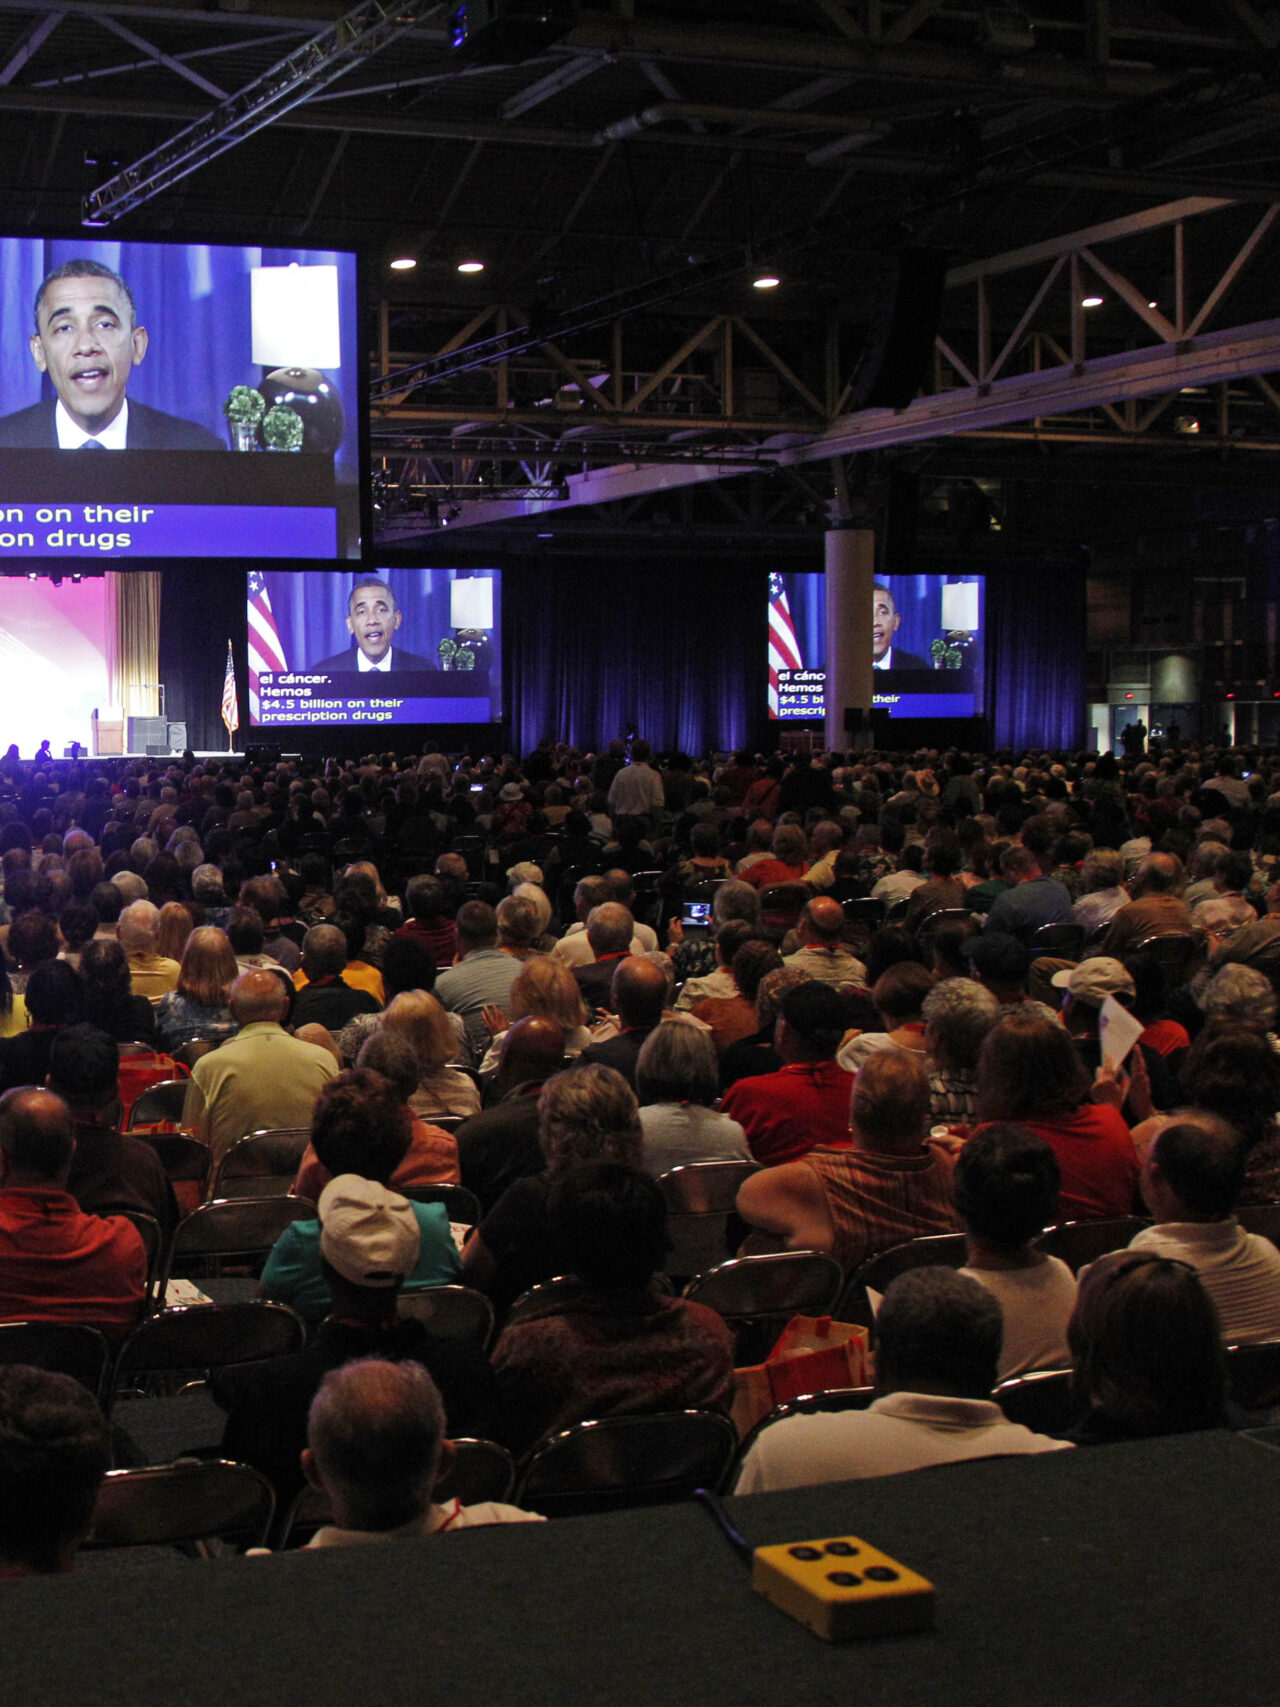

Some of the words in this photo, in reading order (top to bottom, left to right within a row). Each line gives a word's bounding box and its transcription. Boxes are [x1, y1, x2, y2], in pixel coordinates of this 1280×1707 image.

[35, 508, 72, 523] on
[83, 504, 154, 523] their
[46, 529, 132, 550] drugs
[259, 673, 274, 684] el
[278, 672, 332, 684] cáncer.
[260, 686, 313, 697] Hemos
[778, 683, 824, 693] Hemos
[261, 699, 296, 711] $4.5
[299, 698, 343, 709] billion
[346, 700, 366, 709] on
[369, 698, 404, 708] their
[261, 711, 348, 723] prescription
[352, 710, 393, 722] drugs
